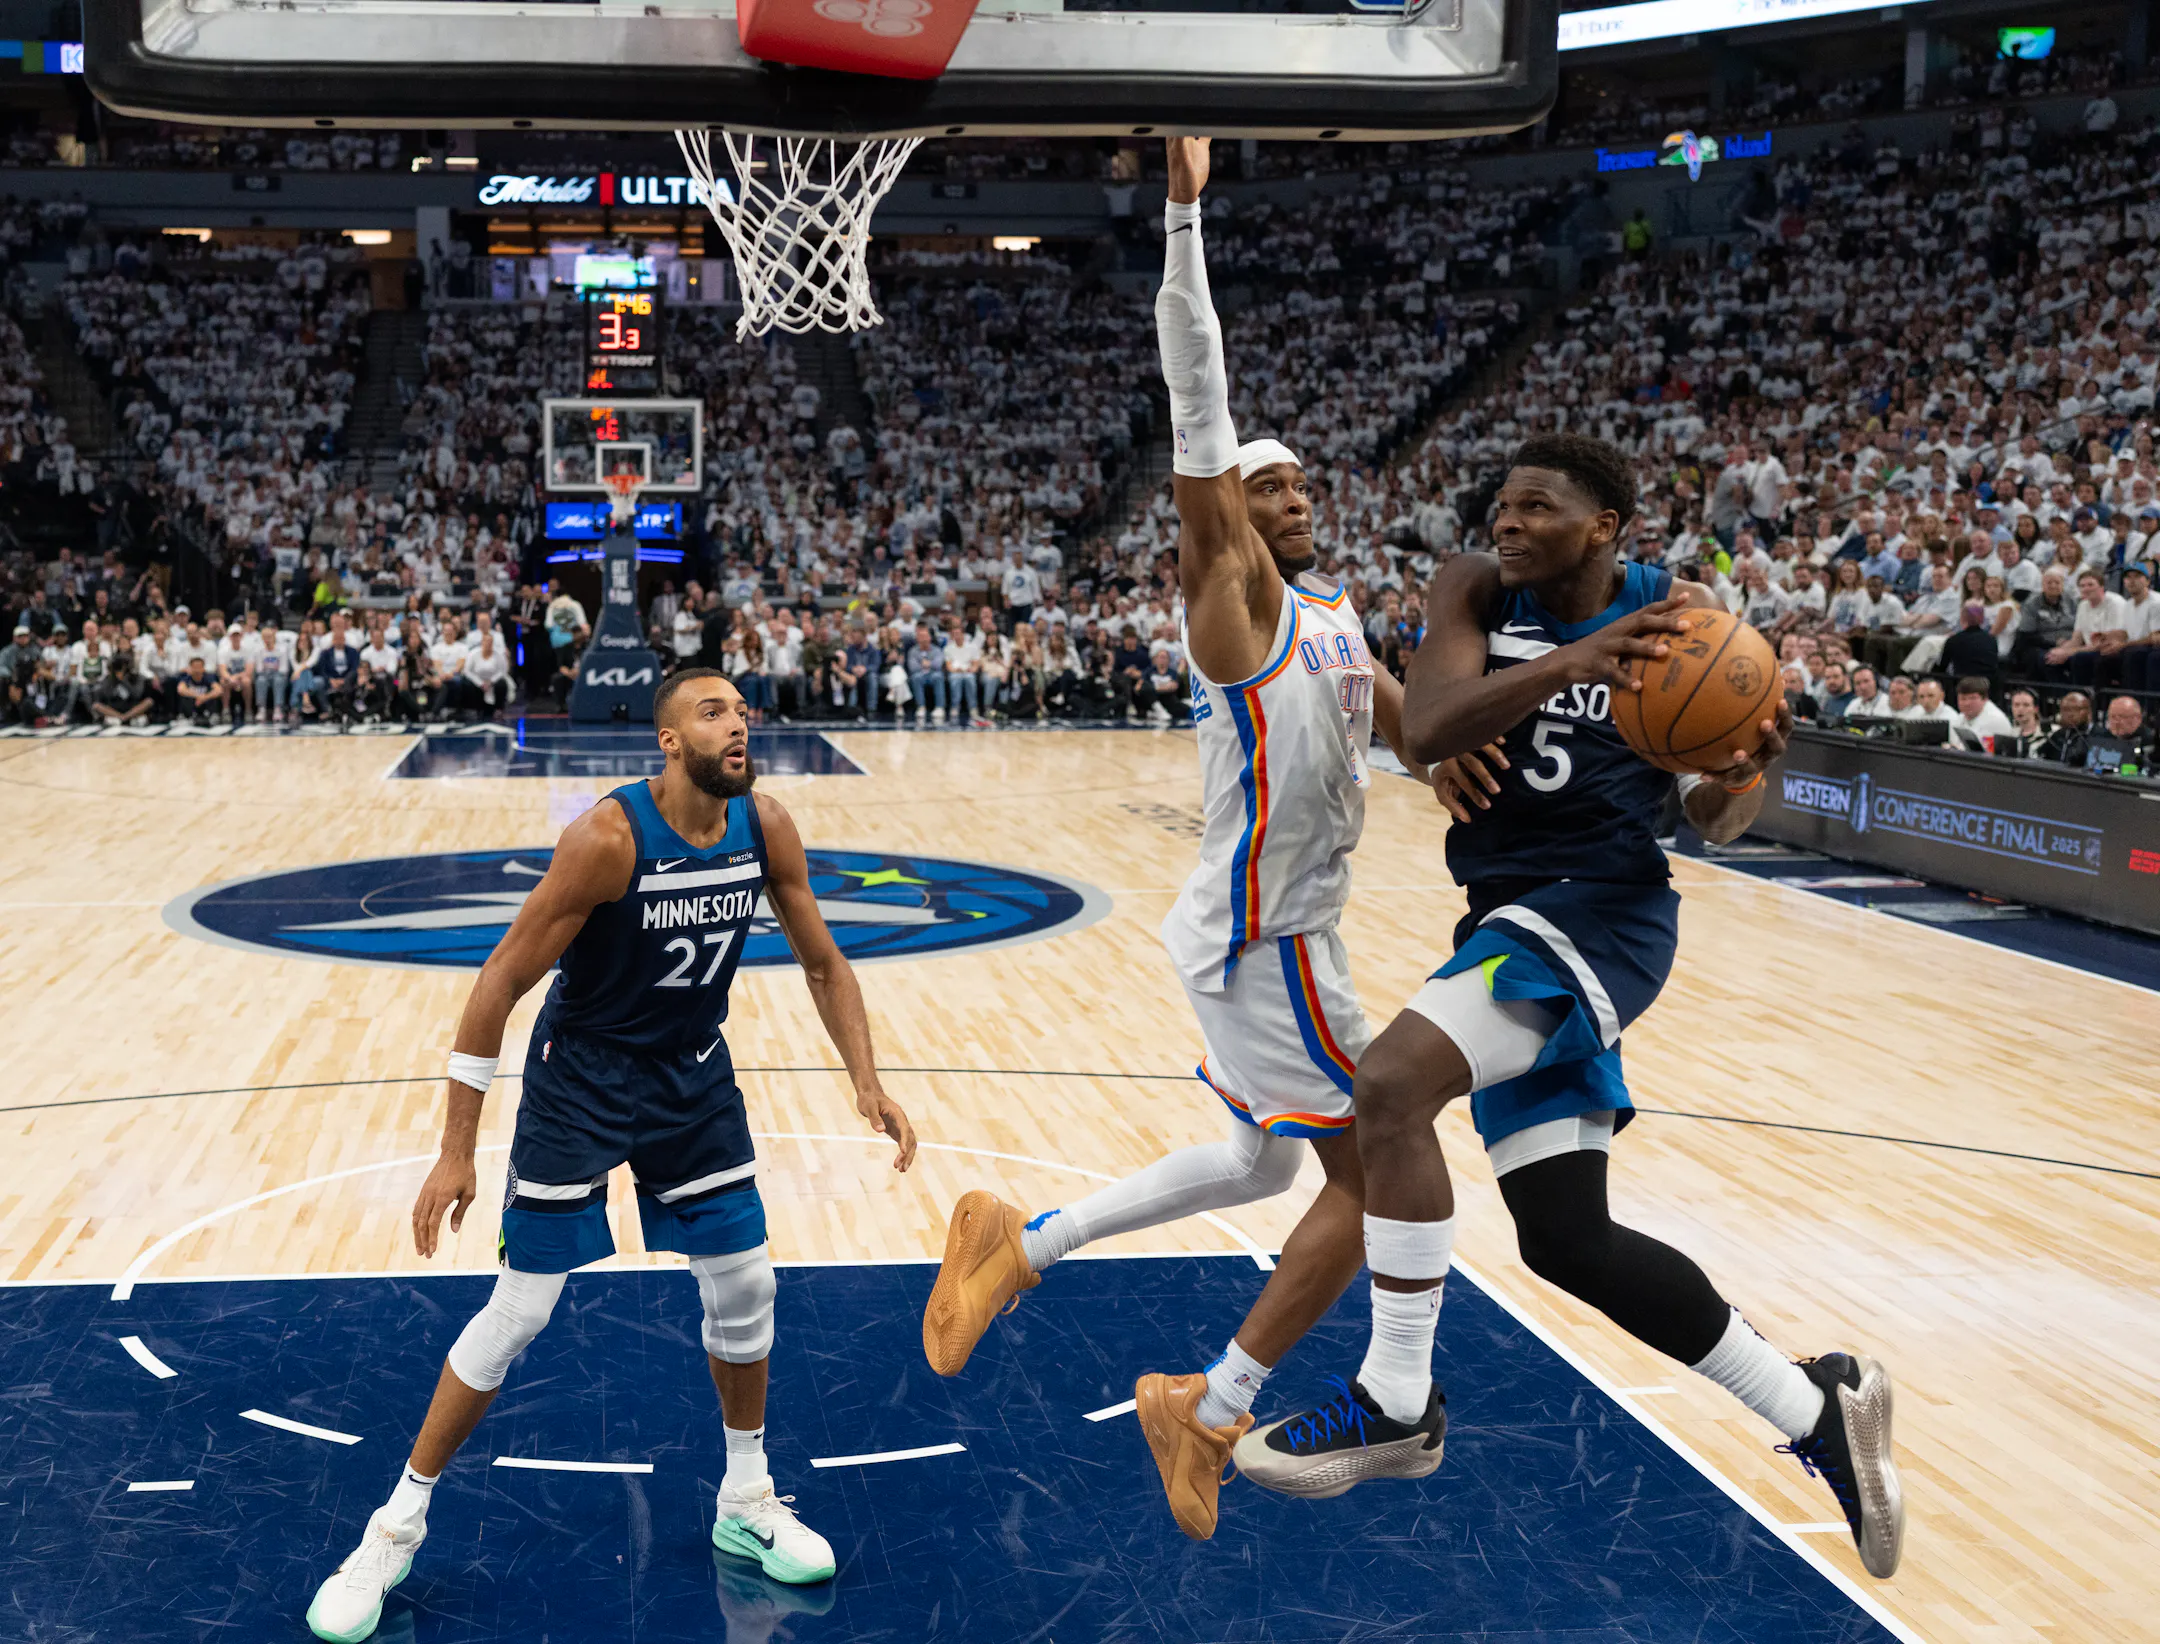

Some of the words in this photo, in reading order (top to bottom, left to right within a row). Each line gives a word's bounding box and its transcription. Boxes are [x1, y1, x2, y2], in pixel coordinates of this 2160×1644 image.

[1725, 130, 1773, 160] Island
[479, 174, 597, 205] Michelob
[621, 176, 735, 205] ULTRA
[1522, 719, 1574, 792] 5
[1782, 776, 1850, 813] WESTERN
[1873, 795, 1988, 843] CONFERENCE
[1991, 818, 2048, 856] FINAL
[2051, 836, 2081, 856] 2025
[732, 852, 754, 863] sezzle
[642, 888, 754, 930] MINNESOTA
[653, 928, 737, 988] 27
